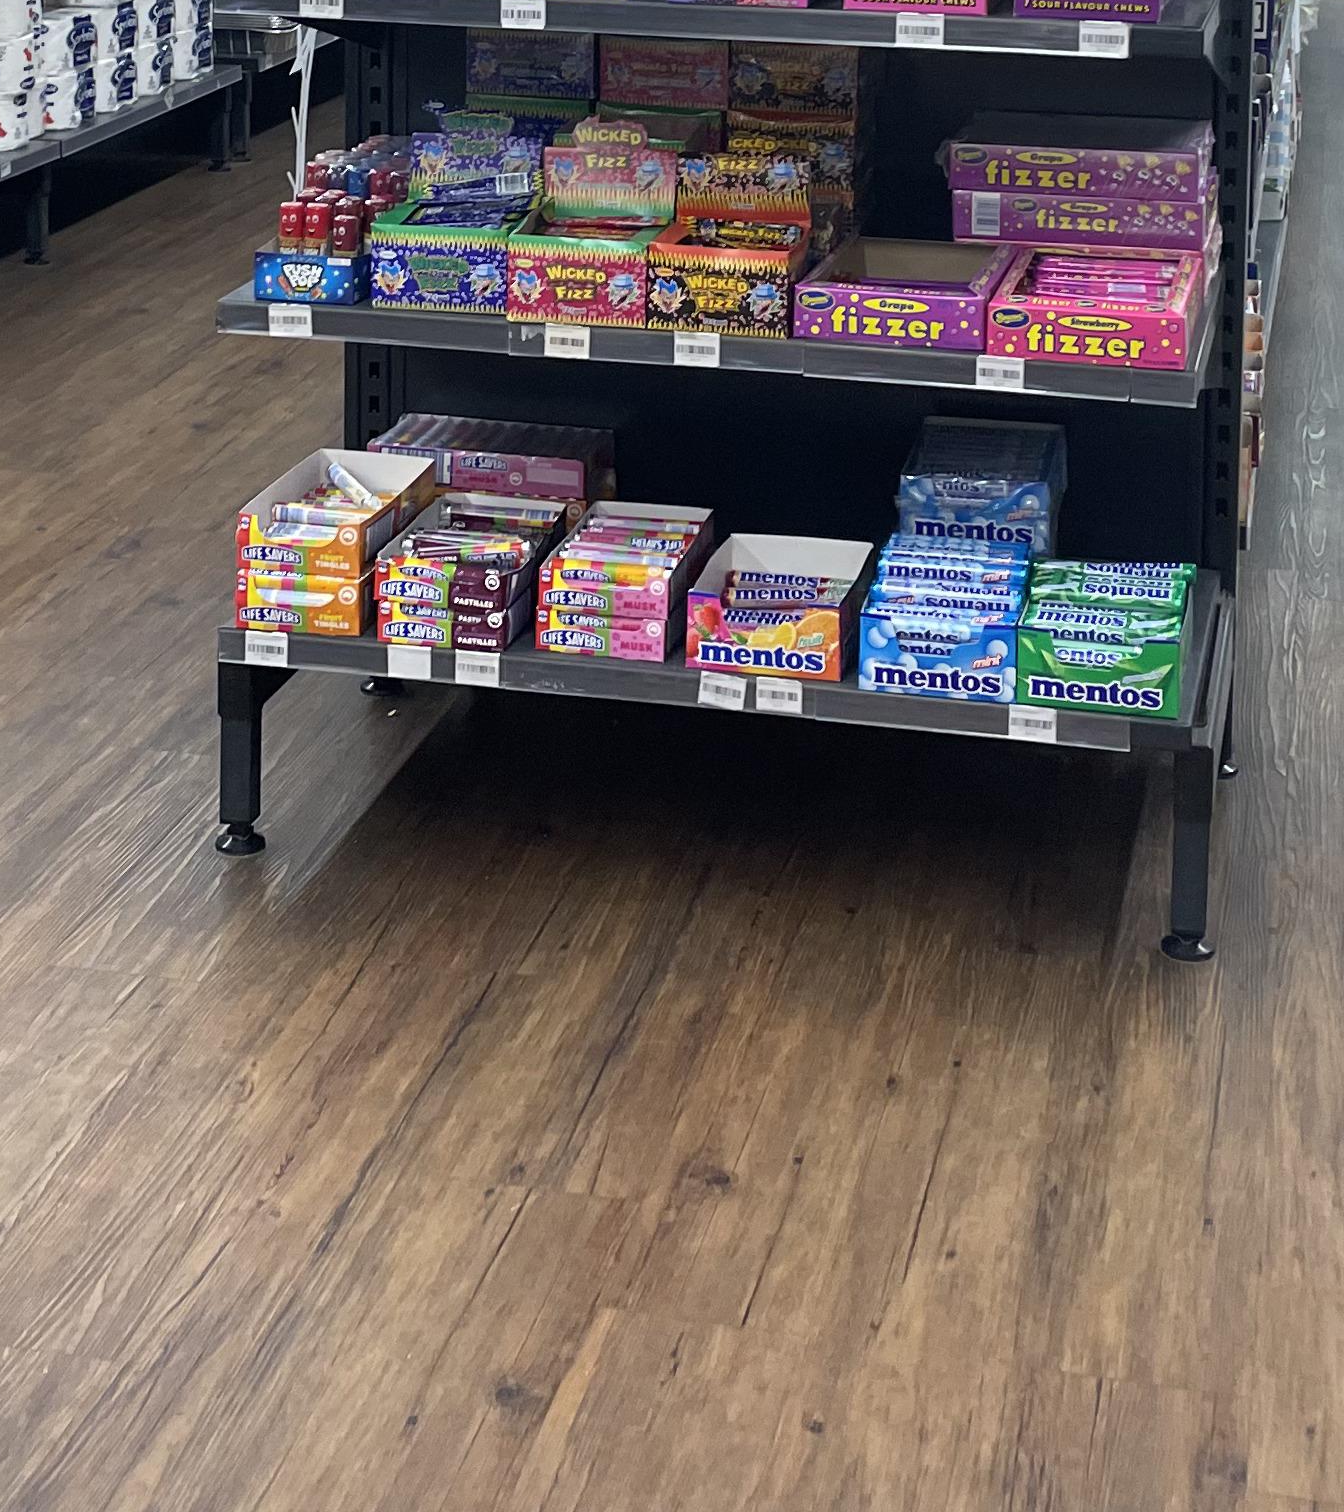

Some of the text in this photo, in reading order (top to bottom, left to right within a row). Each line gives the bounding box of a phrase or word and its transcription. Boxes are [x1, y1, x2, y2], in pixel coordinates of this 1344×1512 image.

[1032, 0, 1150, 13] SOUR FLAVOUR CHEWS
[575, 126, 642, 145] WICKED
[585, 153, 629, 169] FIZZ
[716, 156, 760, 172] FIZZ
[1029, 152, 1064, 165] Grape
[984, 160, 1092, 189] fizzer
[1035, 208, 1118, 233] fizzer
[282, 263, 324, 278] PUSH
[545, 264, 607, 284] WICKED
[289, 274, 321, 290] POP
[686, 274, 749, 294] WICKED
[555, 285, 595, 300] FIZZ
[697, 295, 739, 310] FIZZ
[879, 299, 914, 313] Grape
[830, 306, 945, 341] fizzer
[1069, 317, 1121, 331] Strawberry
[1025, 323, 1146, 360] fizzer
[914, 519, 1035, 544] mentos
[243, 546, 302, 564] LIFE SAVERS
[740, 571, 819, 588] mentos
[887, 565, 973, 582] mentos
[981, 570, 1012, 583] mint
[381, 582, 442, 602] LIFE SAVERS
[545, 591, 607, 608] LIFE SAVERS
[734, 588, 817, 601] mentos
[1084, 582, 1171, 600] mentos
[454, 596, 495, 609] PASTILLES
[623, 600, 657, 612] MUSK
[241, 608, 300, 624] LIFE SAVERS
[1036, 610, 1127, 628] mentos
[385, 623, 445, 642] LIFE SAVERS
[457, 636, 498, 648] PASTILLES
[542, 633, 603, 650] LIFE SAVERS
[620, 641, 654, 653] MUSK
[700, 642, 826, 672] mentos
[972, 653, 1004, 670] mint
[873, 662, 1002, 695] mentos
[1030, 677, 1162, 708] mentos
